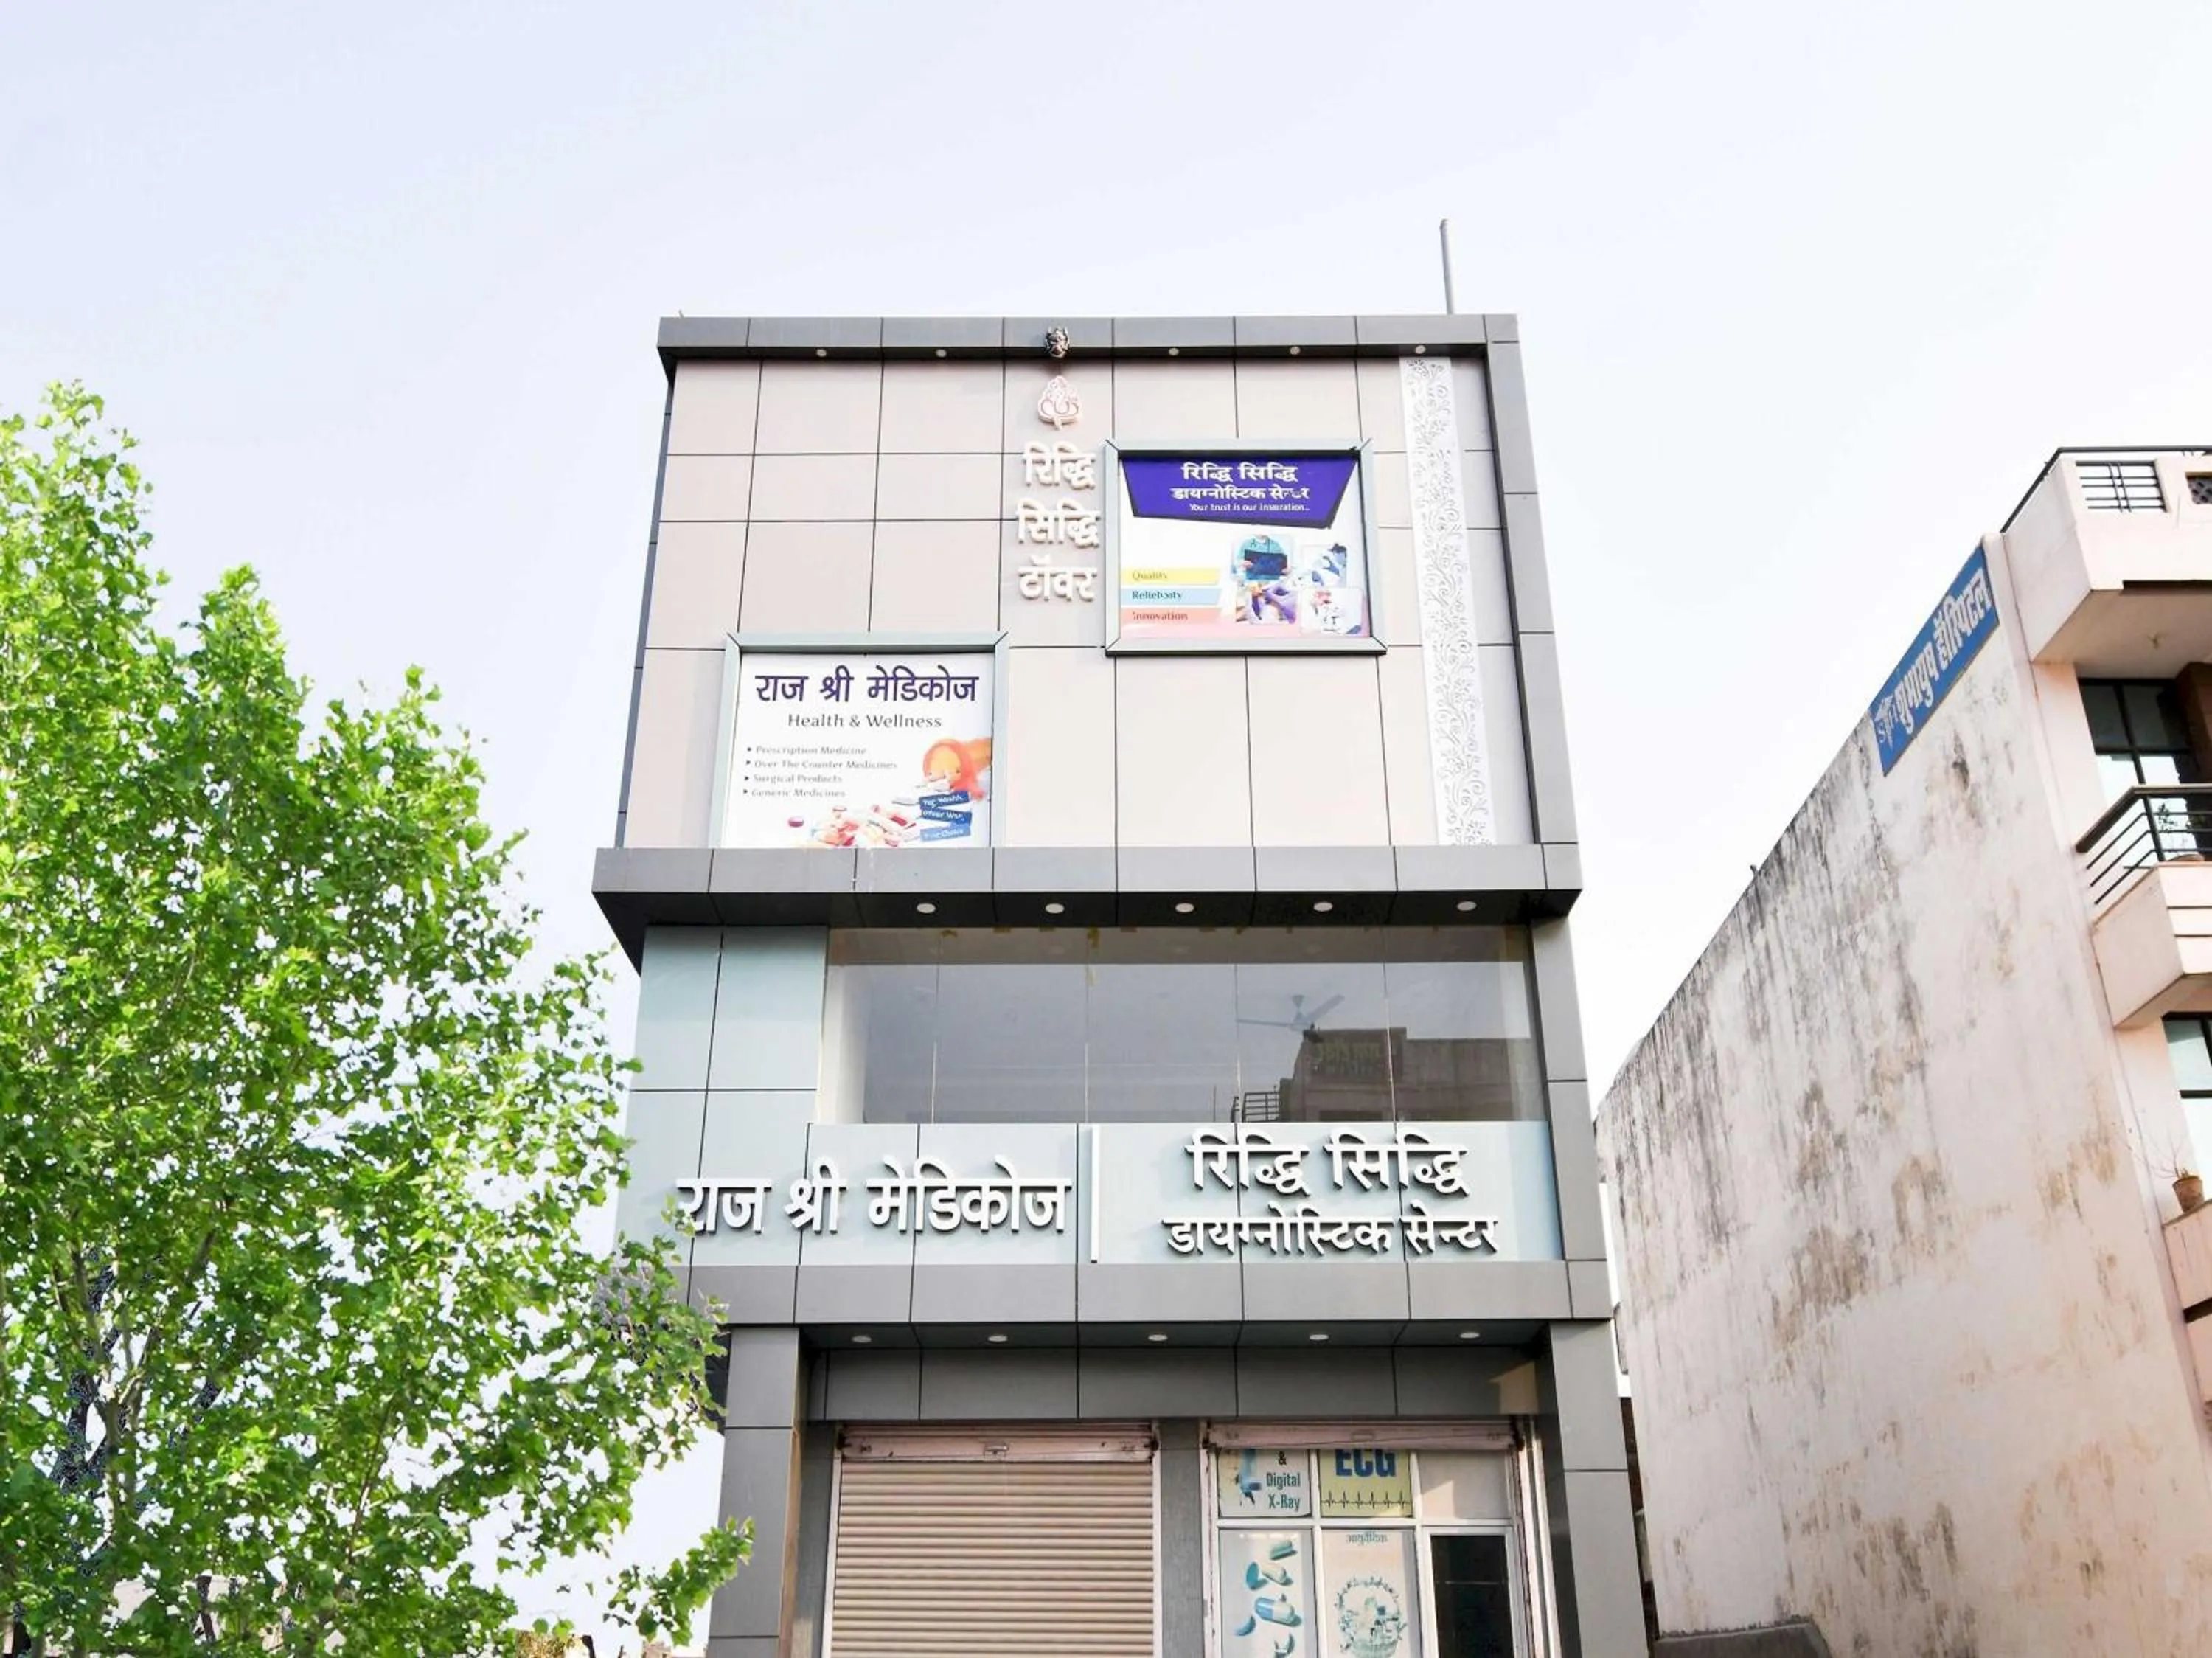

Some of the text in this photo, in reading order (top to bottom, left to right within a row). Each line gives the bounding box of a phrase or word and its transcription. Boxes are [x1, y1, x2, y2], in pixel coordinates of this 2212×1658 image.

[1023, 442, 1096, 490] रिद्धि
[1181, 462, 1298, 482] रिद्धि सिद्धि
[1169, 484, 1267, 499] डायग्नोस्टिक
[1015, 498, 1101, 549] सिद्धि
[1018, 554, 1098, 603] टॉवर
[755, 665, 979, 702] राज श्री मेडिकोज
[787, 714, 942, 728] Health & Wellness
[756, 746, 866, 756] Prescription Medicine
[782, 760, 799, 768] The
[801, 760, 843, 769] Counter
[846, 760, 897, 769] Medicines
[753, 774, 843, 784] Surgical Products
[793, 788, 846, 797] Medicines
[1183, 1127, 1470, 1197] रिद्धि सिद्धि
[676, 1155, 1073, 1234] राज श्री मेडिकोज
[1161, 1199, 1498, 1256] डायग्नोस्टिक सेन्टर
[1278, 1451, 1287, 1466] &
[1335, 1449, 1396, 1477] ECG
[1266, 1472, 1301, 1490] Digital
[1268, 1494, 1301, 1512] X-Ray
